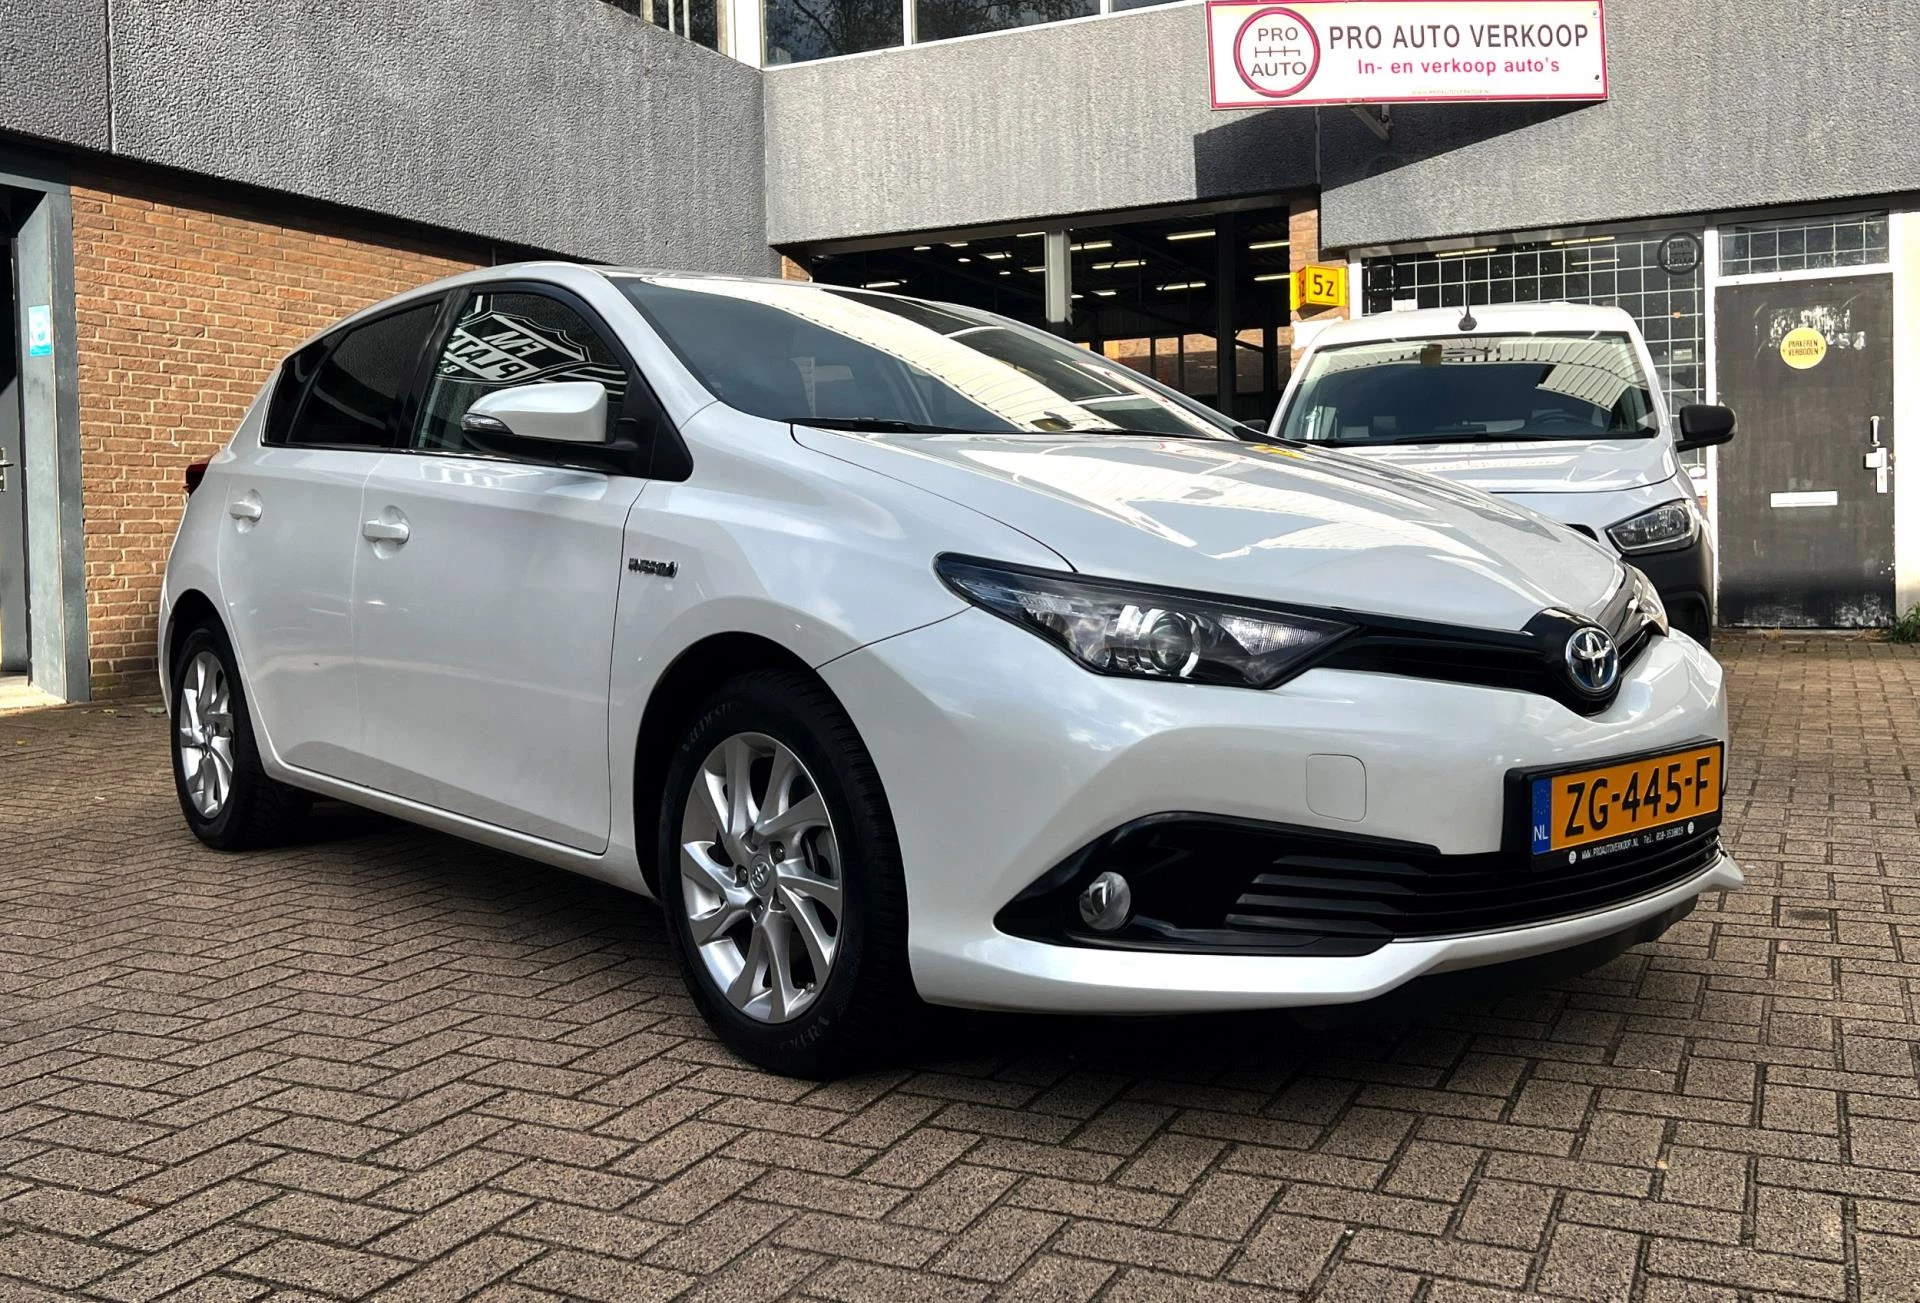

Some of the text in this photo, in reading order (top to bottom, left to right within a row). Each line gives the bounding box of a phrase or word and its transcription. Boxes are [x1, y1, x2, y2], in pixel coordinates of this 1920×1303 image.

[1257, 26, 1299, 42] PRO
[1329, 23, 1589, 49] PRO AUTO VERKOOP
[1250, 61, 1307, 77] AUTO
[1357, 57, 1560, 76] In- en verkoop auto's
[1788, 340, 1818, 348] PARKEREN
[1788, 347, 1819, 356] VERBODEN
[1565, 756, 1711, 838] ZG-445-F
[1533, 825, 1549, 842] NL
